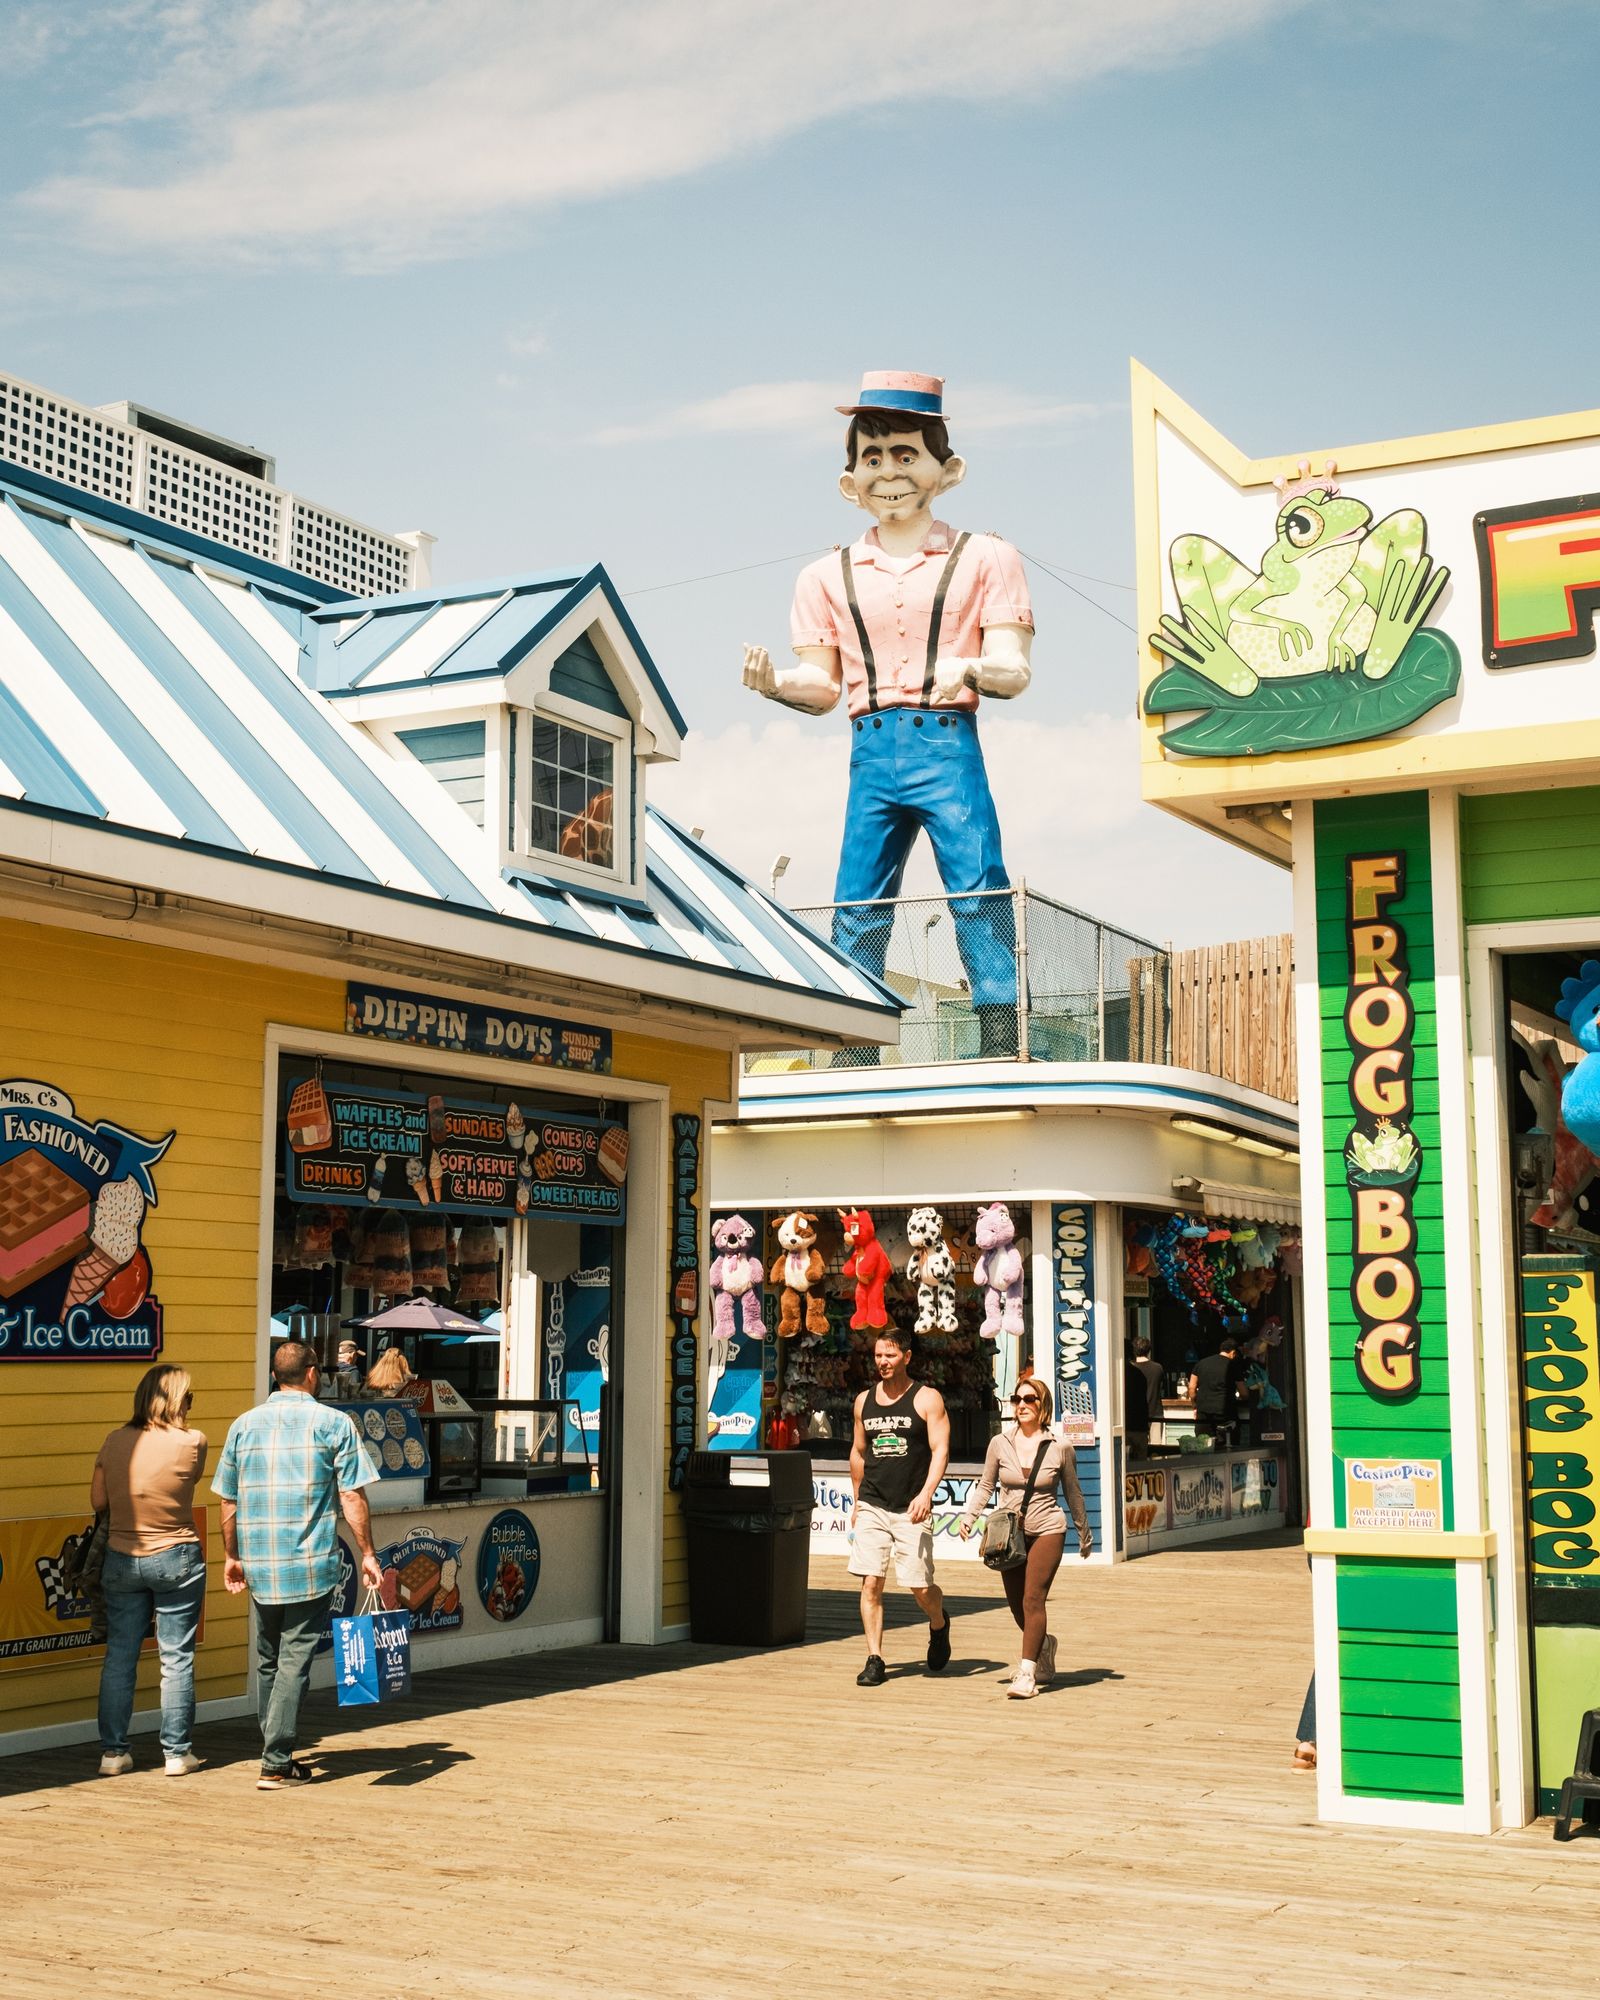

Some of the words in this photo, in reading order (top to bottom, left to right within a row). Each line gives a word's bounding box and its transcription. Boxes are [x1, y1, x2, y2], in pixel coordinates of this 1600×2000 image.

[1349, 856, 1408, 1116] FROG
[363, 994, 468, 1041] DIPPIN
[485, 1017, 553, 1055] DOTS
[561, 1030, 601, 1050] SUNDAE
[567, 1045, 594, 1063] SHOP
[335, 1103, 402, 1127] WAFFLES
[404, 1113, 426, 1130] and
[444, 1117, 504, 1139] SUNDAES
[3, 1114, 111, 1176] FASHIONED
[342, 1129, 368, 1148] ICE
[369, 1130, 420, 1153] CREAM
[543, 1128, 583, 1148] CONES
[585, 1134, 597, 1150] &
[303, 1163, 363, 1186] DRINKS
[440, 1155, 474, 1172] SOFT
[476, 1157, 516, 1177] SERVE
[554, 1154, 584, 1173] CUPS
[453, 1179, 464, 1195] &
[466, 1178, 504, 1198] HARD
[532, 1184, 574, 1203] SWEET
[576, 1188, 618, 1208] TREATS
[678, 1117, 699, 1254] WAFFLES
[675, 1255, 697, 1269] AND
[1356, 1188, 1415, 1391] BOG
[24, 1309, 63, 1347] Ice
[67, 1308, 150, 1347] Cream
[675, 1317, 694, 1376] ICE
[1521, 1274, 1594, 1433] FROG
[1145, 1470, 1166, 1502] TO
[1353, 1509, 1372, 1517] AND
[1374, 1509, 1405, 1518] CREDIT
[1409, 1510, 1436, 1519] CARDS
[1355, 1517, 1405, 1527] ACCEPTED
[1409, 1518, 1434, 1528] HERE
[1528, 1452, 1600, 1570] BOG
[491, 1525, 526, 1544] Bubble
[830, 1519, 846, 1532] All
[498, 1543, 538, 1562] Waffles
[419, 1613, 432, 1629] Ice
[432, 1611, 460, 1626] Cream
[11, 1642, 24, 1655] AT
[25, 1637, 58, 1651] GRANT
[58, 1632, 94, 1649] AVENUE
[373, 1624, 408, 1652] Regent
[393, 1651, 403, 1665] Co
